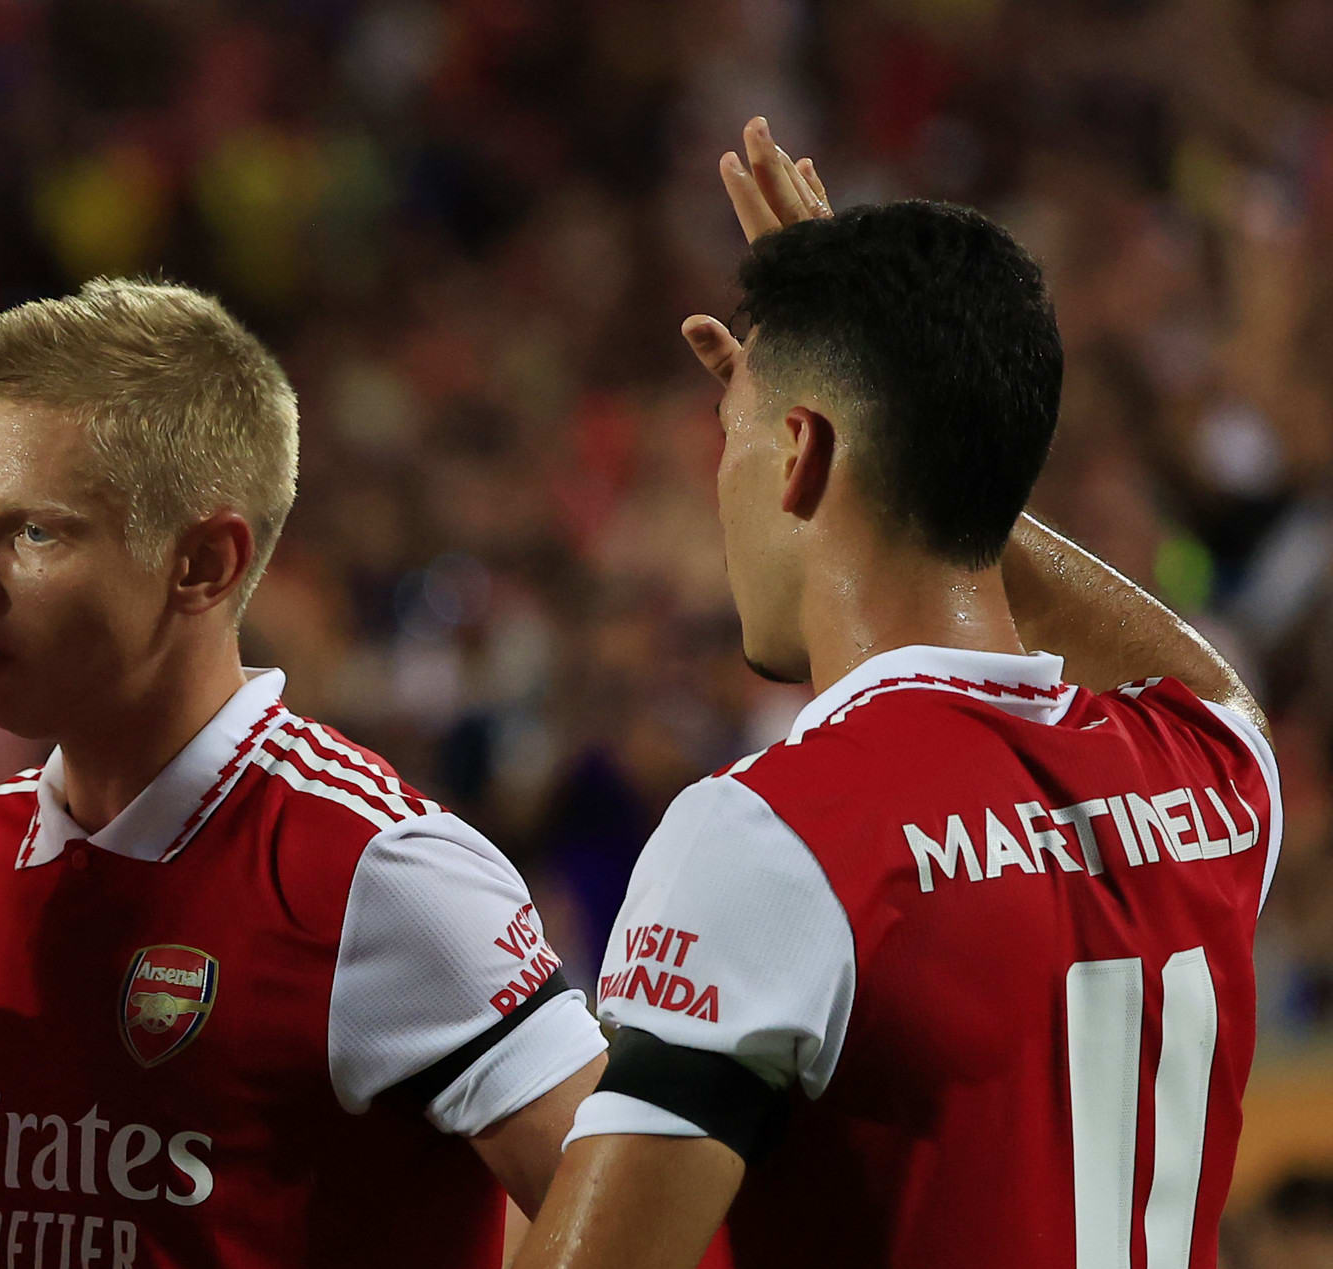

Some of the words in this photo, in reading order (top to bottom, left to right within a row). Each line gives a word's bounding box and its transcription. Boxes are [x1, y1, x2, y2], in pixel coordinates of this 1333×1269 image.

[902, 780, 1260, 892] MARTINELLI
[626, 923, 700, 968] VISIT
[136, 961, 205, 987] Arsenal
